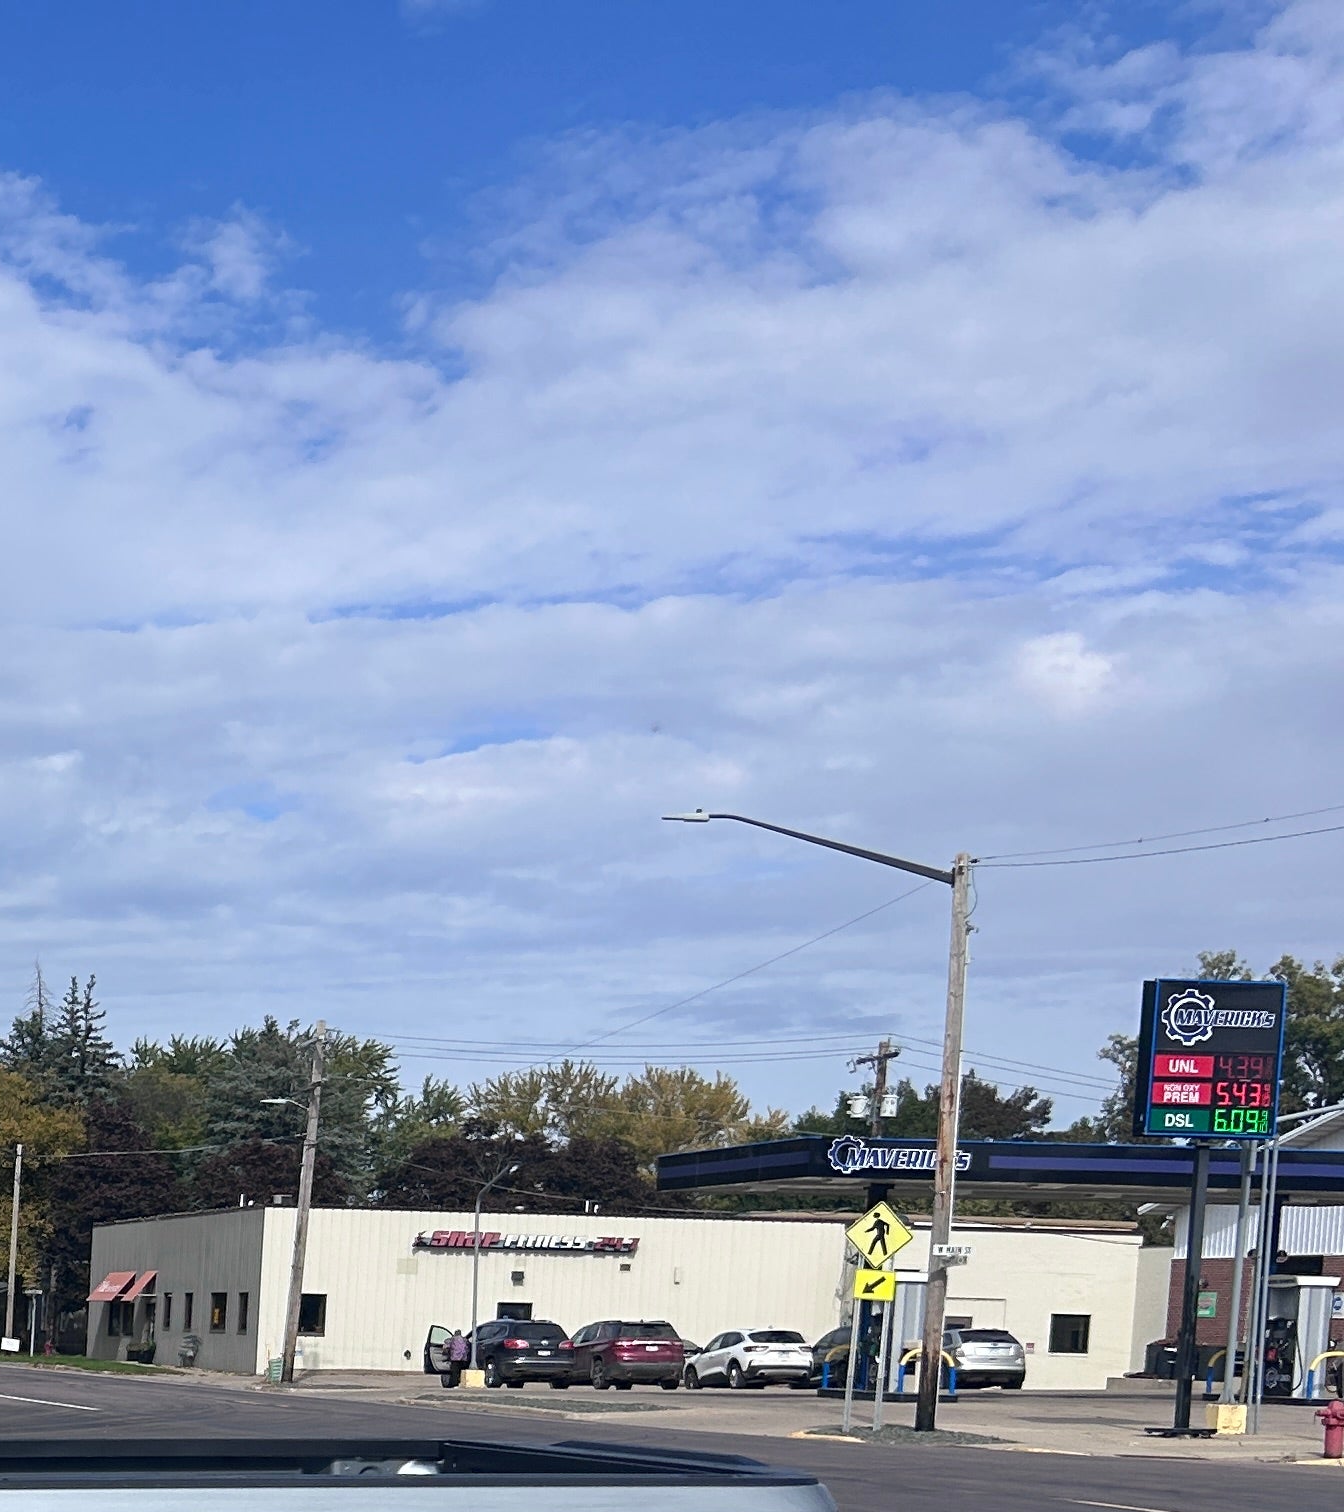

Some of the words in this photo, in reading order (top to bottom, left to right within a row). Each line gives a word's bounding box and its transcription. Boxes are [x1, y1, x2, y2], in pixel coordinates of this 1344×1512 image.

[1168, 1060, 1199, 1074] UNL
[1163, 1083, 1182, 1092] NON
[1183, 1084, 1201, 1092] OXY
[1163, 1092, 1200, 1103] PREM
[1164, 1114, 1194, 1127] DSL
